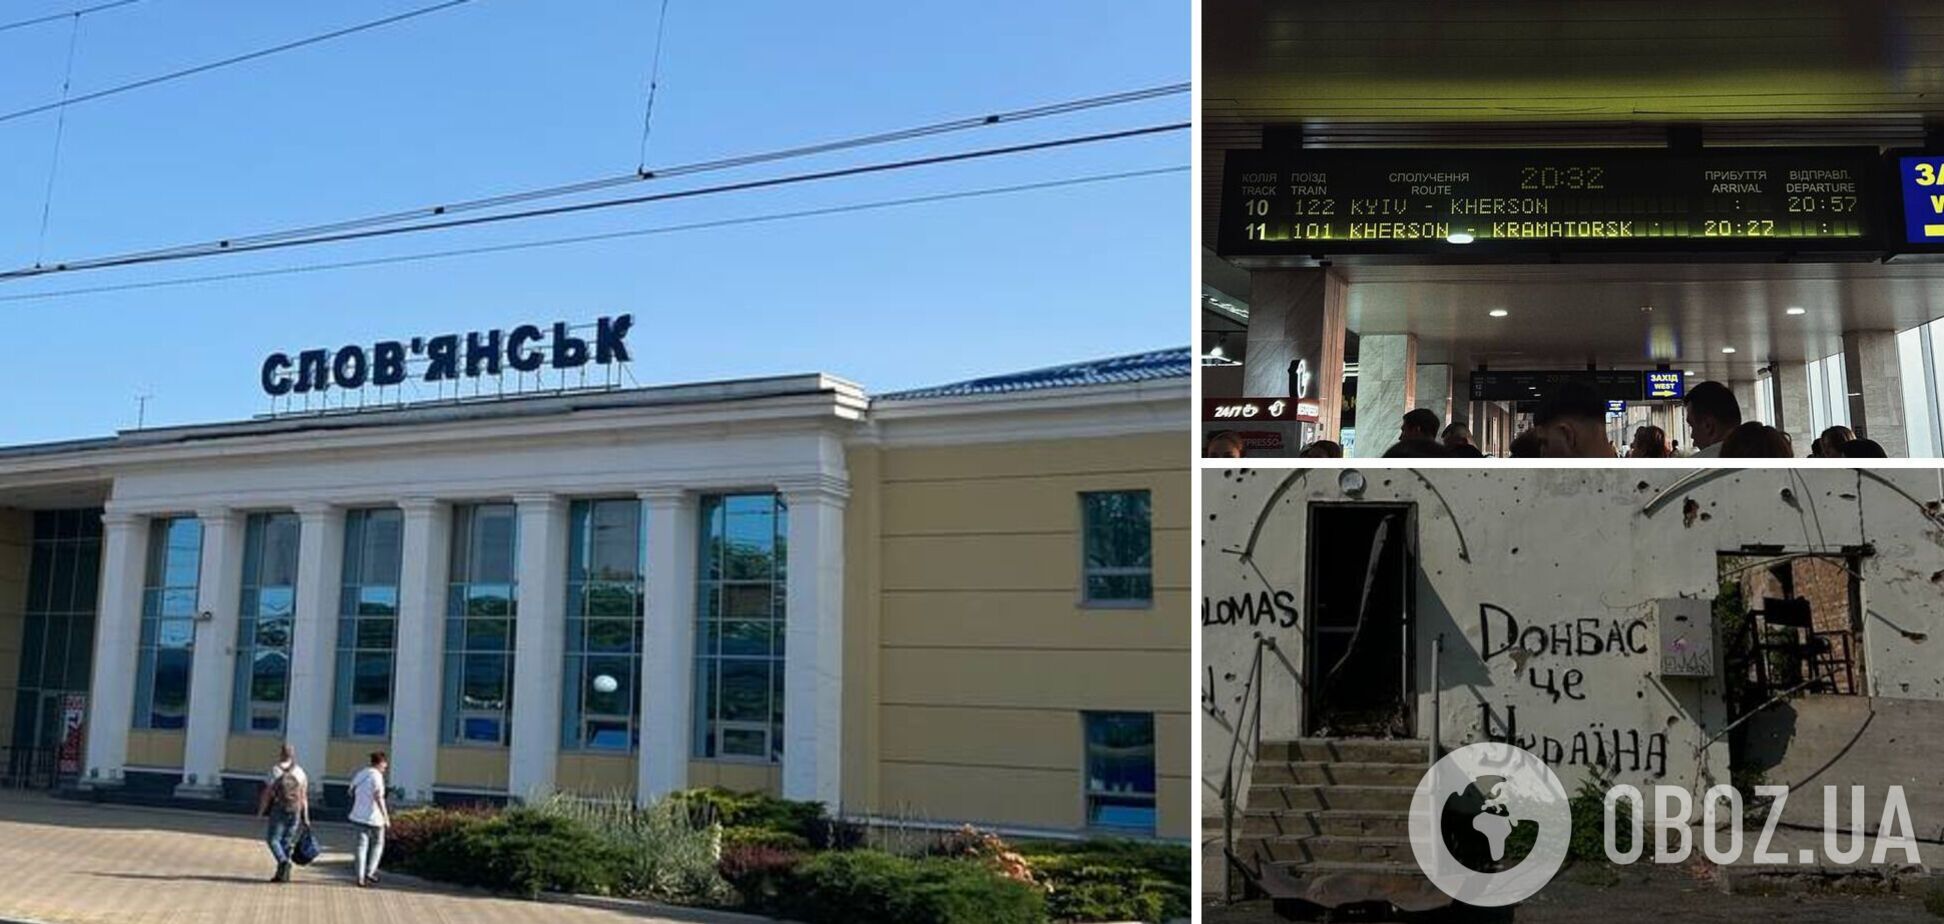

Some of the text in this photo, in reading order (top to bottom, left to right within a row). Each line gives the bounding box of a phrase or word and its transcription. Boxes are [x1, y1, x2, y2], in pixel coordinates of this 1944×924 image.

[1242, 172, 1277, 183] КОЛІЯ
[1291, 172, 1326, 184] ПОЇЗД
[1388, 172, 1470, 183] СПОЛУЧЕННЯ
[1521, 167, 1604, 189] 20:32
[1705, 170, 1767, 181] ПРИБУТТЯ
[1242, 186, 1276, 195] TRACK
[1290, 186, 1327, 195] TRAIN
[1411, 185, 1452, 195] ROUTE
[1712, 183, 1763, 193] ARRIVAL
[1786, 183, 1856, 193] DEPARTURE
[1245, 199, 1269, 216] 10
[1296, 199, 1335, 215] 122
[1351, 199, 1407, 215] KYIV
[1451, 199, 1548, 214] KHERSON
[1788, 196, 1857, 212] 20:57
[1245, 222, 1266, 240] 11
[1293, 222, 1331, 239] 101
[1350, 222, 1449, 239] KHERSON
[1493, 221, 1633, 238] KRAMATORSK
[1704, 220, 1774, 236] 20:27
[261, 313, 634, 395] СЛОВ'ЯНСЬК
[1650, 374, 1678, 383] ЗАХІД
[1214, 406, 1241, 418] 24/7
